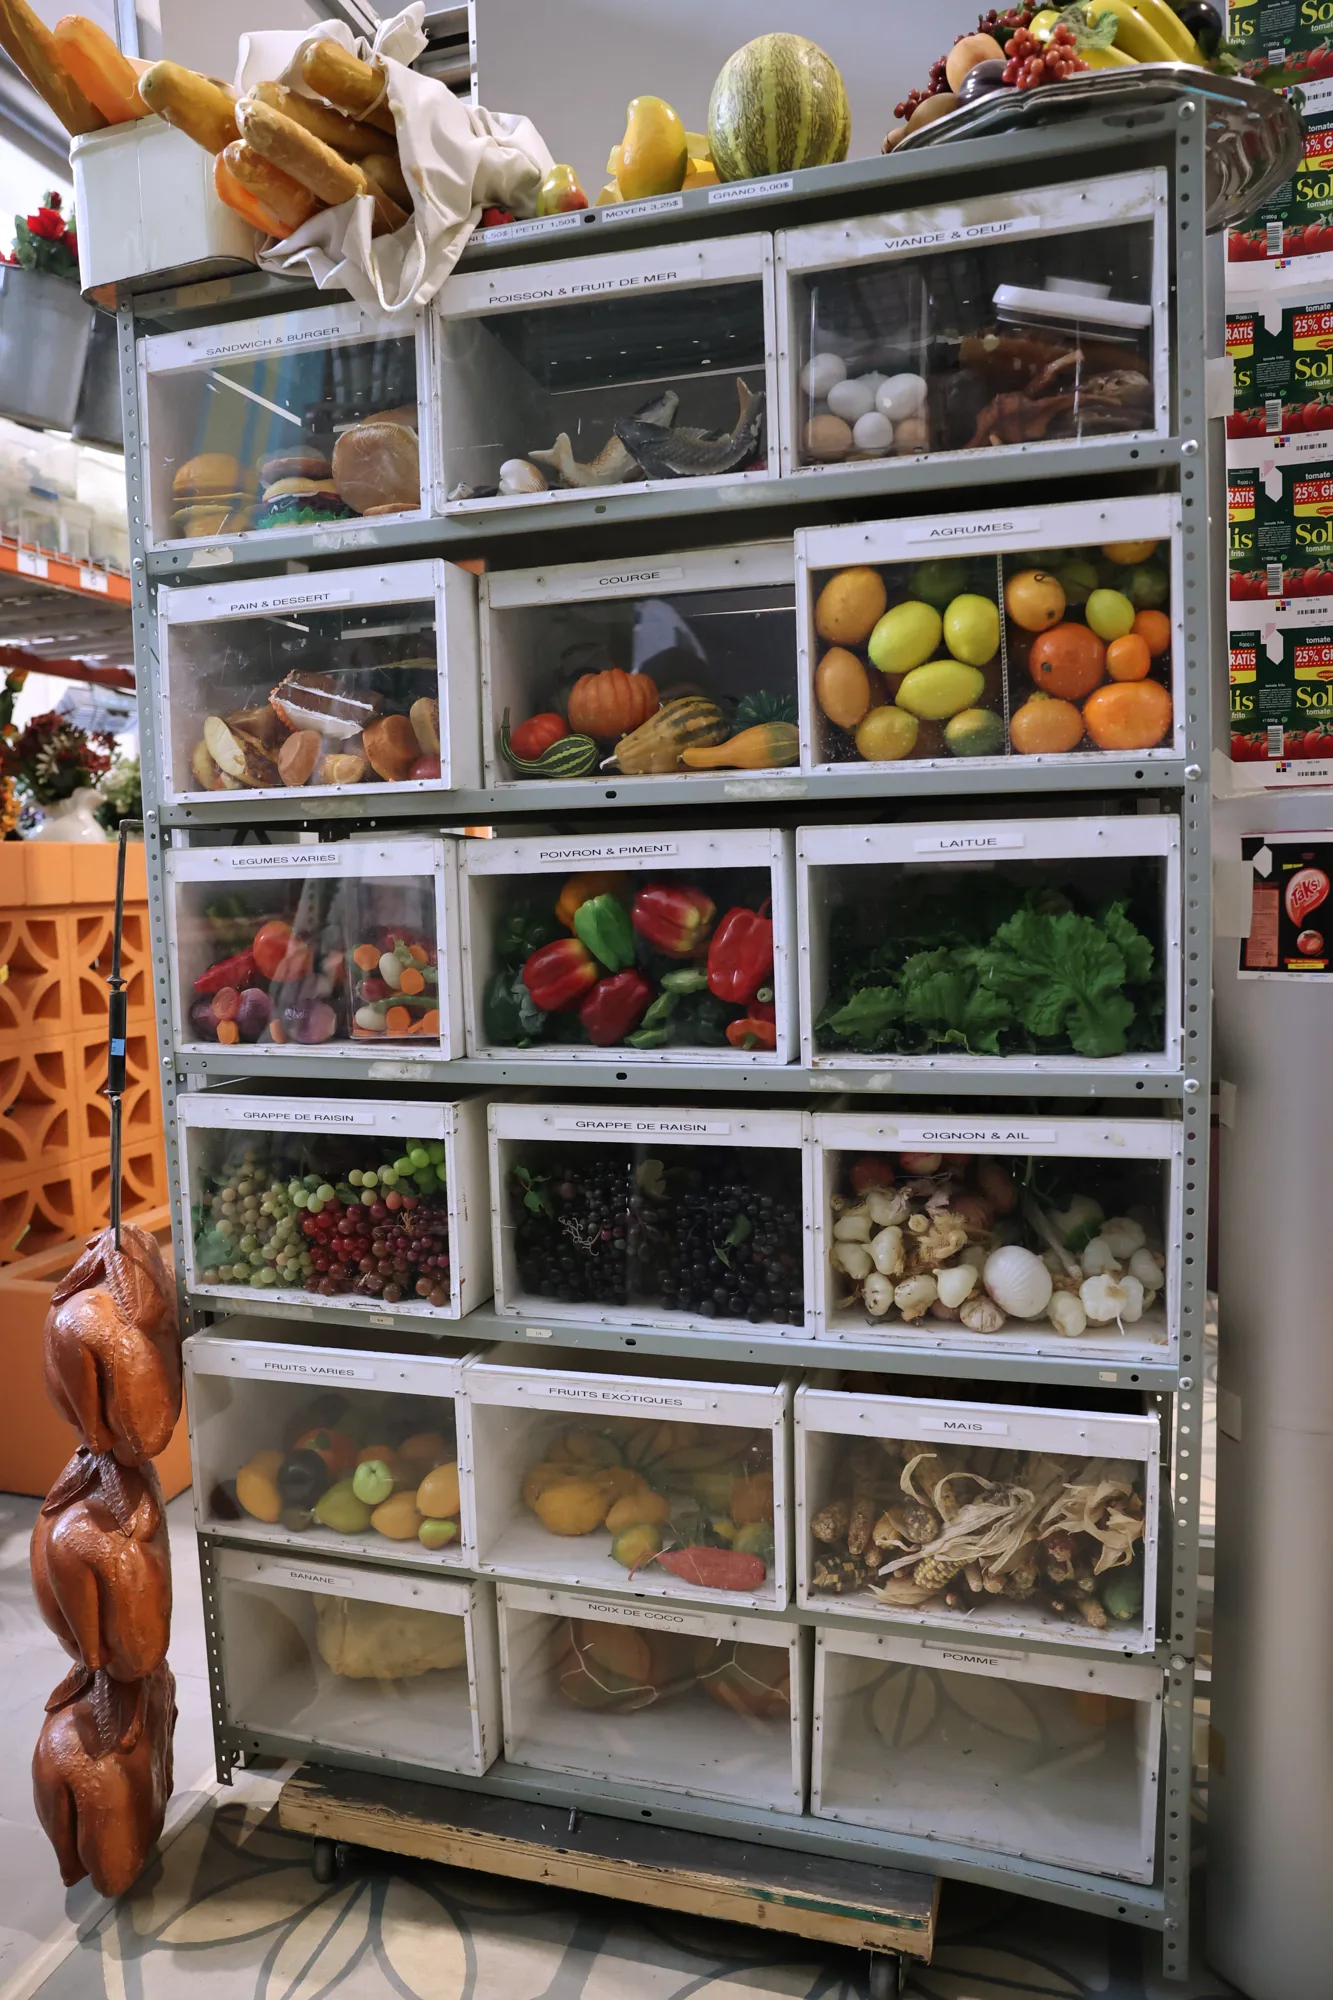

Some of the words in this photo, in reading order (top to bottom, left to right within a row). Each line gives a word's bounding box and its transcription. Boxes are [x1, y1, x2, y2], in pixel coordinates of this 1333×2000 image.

[713, 187, 755, 200] GRAND
[760, 181, 790, 193] 5,00$
[606, 206, 646, 219] MOYEN
[650, 199, 679, 211] 3,25$
[515, 224, 545, 234] PETIT
[550, 217, 577, 228] 1,50$
[885, 233, 945, 249] VIANDE
[951, 231, 961, 239] &
[966, 222, 1013, 236] OEUF
[489, 289, 553, 304] POISSON
[558, 287, 567, 295] &
[571, 280, 615, 293] FRUIT
[619, 277, 640, 287] DE
[644, 272, 677, 283] MER
[1305, 303, 1331, 312] tomate
[1295, 318, 1319, 333] 25%
[206, 338, 272, 356] SANDWICH
[275, 336, 283, 344] &
[287, 326, 340, 342] BURGER
[1295, 353, 1333, 380] Sol
[1305, 378, 1331, 387] tomate
[1305, 471, 1331, 480] tomate
[1295, 485, 1319, 500] 25%
[930, 522, 1014, 537] AGRUMES
[1295, 520, 1333, 546] Sol
[1305, 545, 1331, 553] tomate
[599, 571, 660, 586] COURGE
[230, 602, 258, 611] PAIN
[272, 593, 331, 606] DESSERT
[1306, 636, 1331, 644] tomate
[1296, 649, 1319, 663] 25%
[1296, 684, 1333, 709] Sol
[1231, 711, 1246, 719] frito
[1306, 708, 1331, 716] tomate
[940, 837, 998, 848] LAITUE
[540, 848, 601, 859] POIVRON
[606, 847, 615, 855] &
[619, 844, 672, 854] PIMENT
[243, 1111, 291, 1120] GRAPPE
[294, 1113, 311, 1121] DE
[314, 1114, 354, 1122] RAISIN
[575, 1120, 632, 1129] GRAPPE
[636, 1122, 655, 1130] DE
[660, 1123, 707, 1132] RAISIN
[922, 1132, 986, 1140] OIGNON
[990, 1132, 1001, 1140] &
[1006, 1132, 1030, 1140] AIL
[264, 1362, 307, 1372] FRUITS
[549, 1387, 598, 1399] FRUITS
[602, 1392, 683, 1406] EXOTIQUES
[290, 1571, 335, 1585] BANANE
[588, 1603, 619, 1613] NOIX
[623, 1609, 641, 1617] DE
[644, 1612, 684, 1623] COCO
[942, 1652, 998, 1666] POMME
